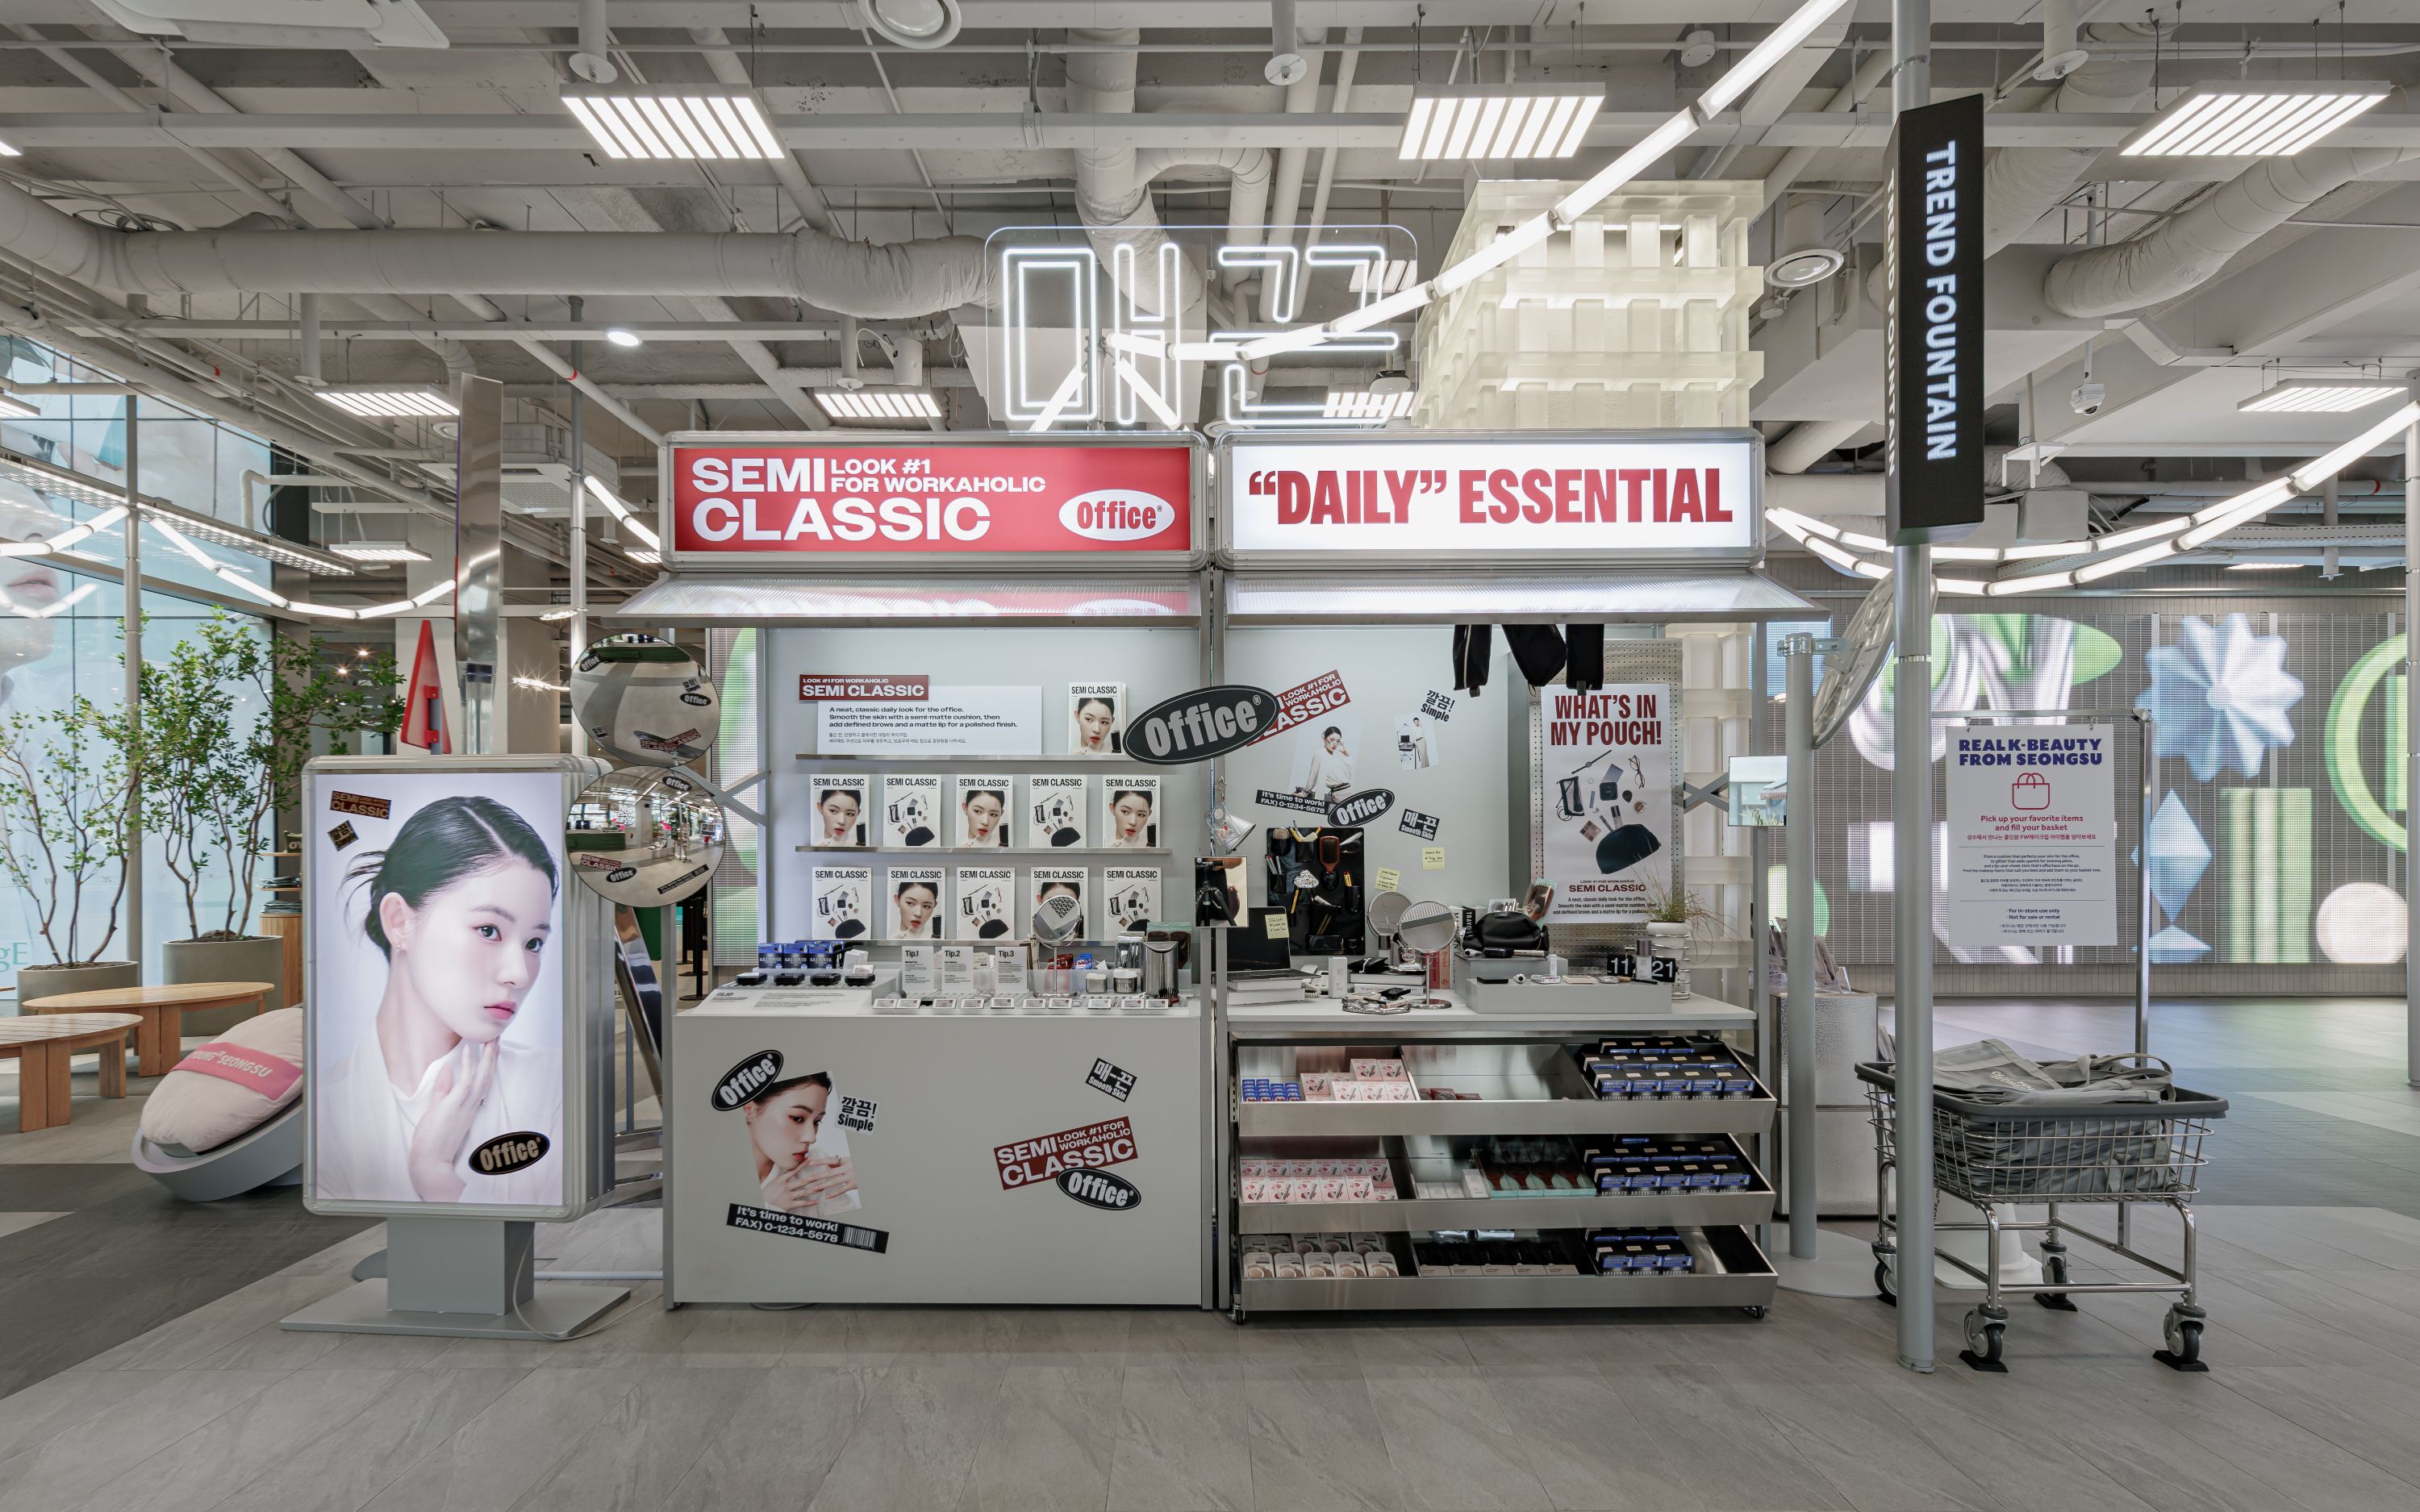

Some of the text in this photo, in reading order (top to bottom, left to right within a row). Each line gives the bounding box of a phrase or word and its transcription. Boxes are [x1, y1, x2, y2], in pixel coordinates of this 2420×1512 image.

[1926, 140, 1957, 460] TREND FOUNTAIN
[692, 458, 931, 493] SEMI LOOK #1
[831, 477, 1046, 493] FOR WORKAHOLIC
[1459, 468, 1733, 524] ESSENTIAL
[692, 498, 991, 541] CLASSIC
[803, 685, 925, 697] SEMI CLASSIC
[1071, 685, 1117, 694] SEMI CLASSIC
[1283, 673, 1336, 701] LOOK #1 FOR
[1285, 679, 1341, 706] WORKAHOLIC
[1425, 689, 1455, 712] 깔끔!
[1637, 694, 1656, 719] IN
[1263, 688, 1346, 736] ASSIC
[1421, 702, 1450, 723] Simple
[1550, 720, 1662, 746] MY POUCH!
[1959, 738, 2102, 752] REAL K-BEAUTY
[1959, 752, 2102, 766] FROM SEONGSU
[813, 778, 865, 786] SEMI CLASSIC
[887, 778, 937, 786] SEMI CLASSIC
[959, 778, 1009, 787] SEMI CLASSIC
[1032, 778, 1083, 787] SEMI CLASSIC
[1105, 779, 1157, 787] SEMI CLASSIC
[332, 792, 359, 803] SEMI
[1261, 798, 1325, 814] FAX) 0-1234-5678
[1276, 793, 1294, 801] time
[1304, 798, 1325, 807] work!
[332, 801, 389, 818] CLASSIC
[1400, 824, 1433, 839] Smooth Skin
[2022, 824, 2040, 832] your
[1033, 871, 1084, 879] SEMI CLASSIC
[1597, 884, 1646, 892] CLASSIC
[905, 950, 919, 958] Tip.1
[945, 950, 961, 958] Tip.2
[998, 950, 1015, 958] Tip.3
[1610, 957, 1629, 975] 11
[1651, 960, 1673, 978] 21
[216, 1055, 273, 1077] SEONGSU
[1088, 1076, 1127, 1100] Smooth Skin
[841, 1096, 878, 1119] 깔끔!
[837, 1113, 874, 1132] Simple
[997, 1121, 1125, 1164] SEMI LOOK #1 FOR
[1058, 1127, 1131, 1151] WORKAHOLIC
[1002, 1139, 1134, 1185] CLASSIC
[736, 1206, 839, 1232] It's time to work!
[735, 1217, 838, 1243] FAX) 0-1234-5678
